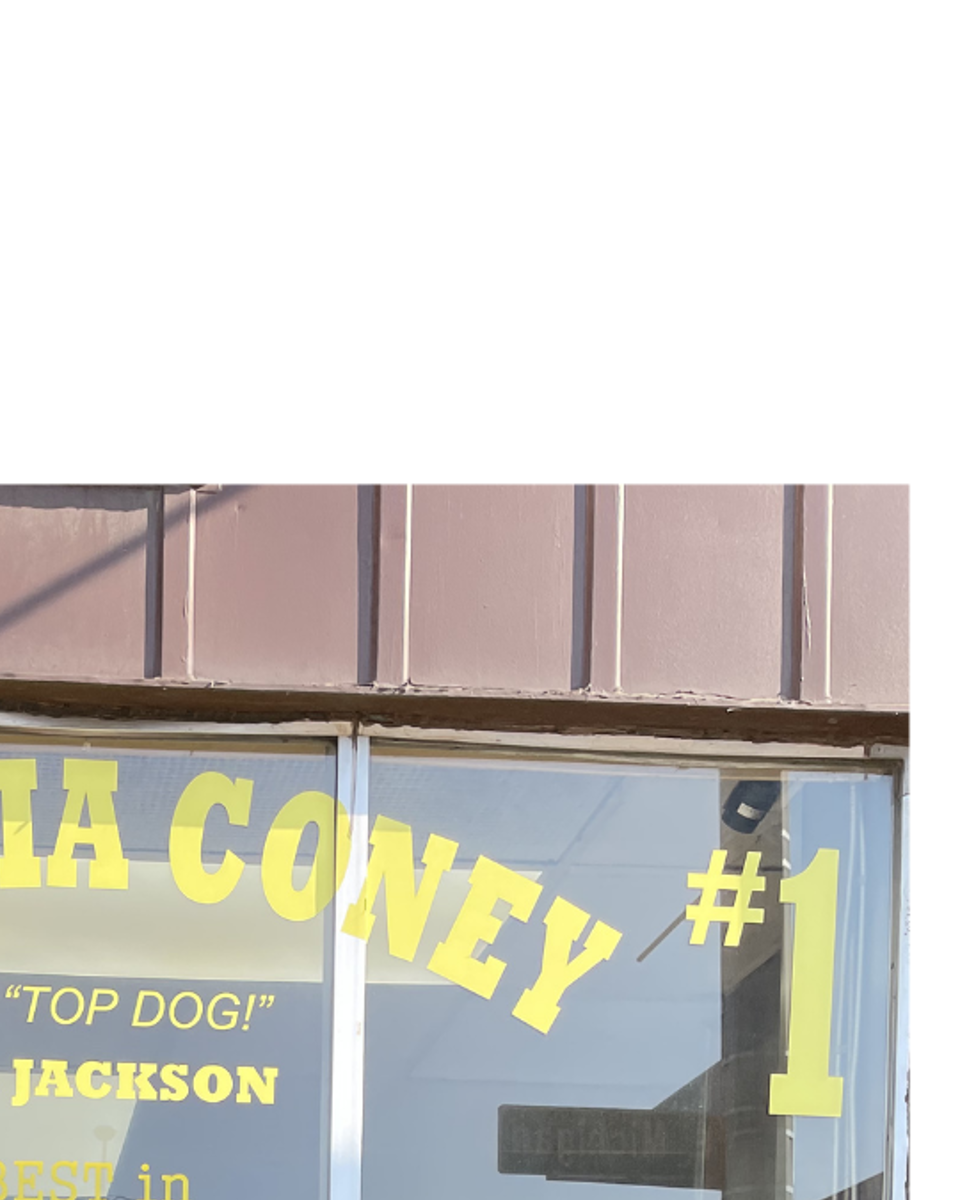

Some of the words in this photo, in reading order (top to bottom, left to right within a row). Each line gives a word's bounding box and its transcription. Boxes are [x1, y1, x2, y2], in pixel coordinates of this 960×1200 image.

[169, 771, 622, 1034] CONEY
[5, 985, 119, 1026] “TOP
[131, 989, 275, 1031] DOG!”
[685, 847, 844, 1117] #1
[11, 1058, 279, 1106] JACKSON
